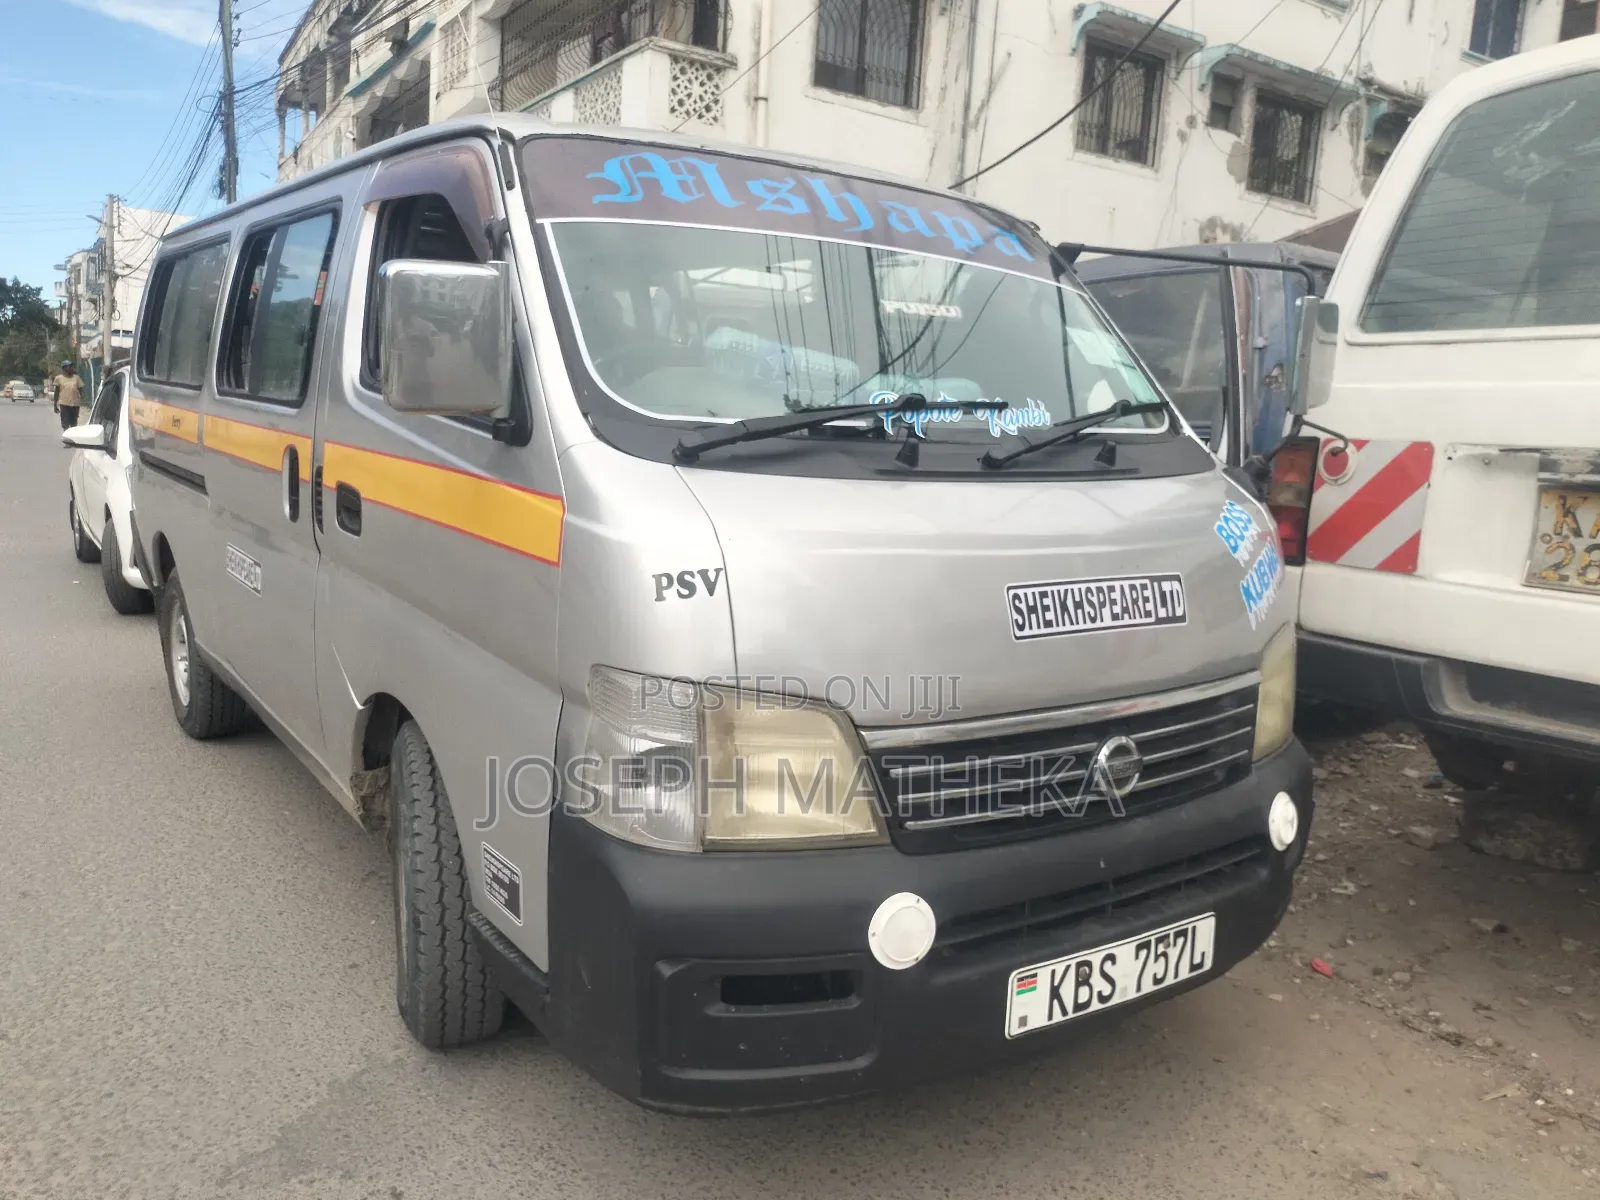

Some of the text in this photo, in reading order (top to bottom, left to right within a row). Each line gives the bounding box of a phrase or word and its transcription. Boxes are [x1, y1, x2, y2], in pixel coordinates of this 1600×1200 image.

[1213, 499, 1257, 560] BOSS
[652, 568, 723, 602] PSV
[1012, 581, 1185, 632] SHEIKHSPEARE LTD
[1047, 925, 1206, 1022] KBS 757L
